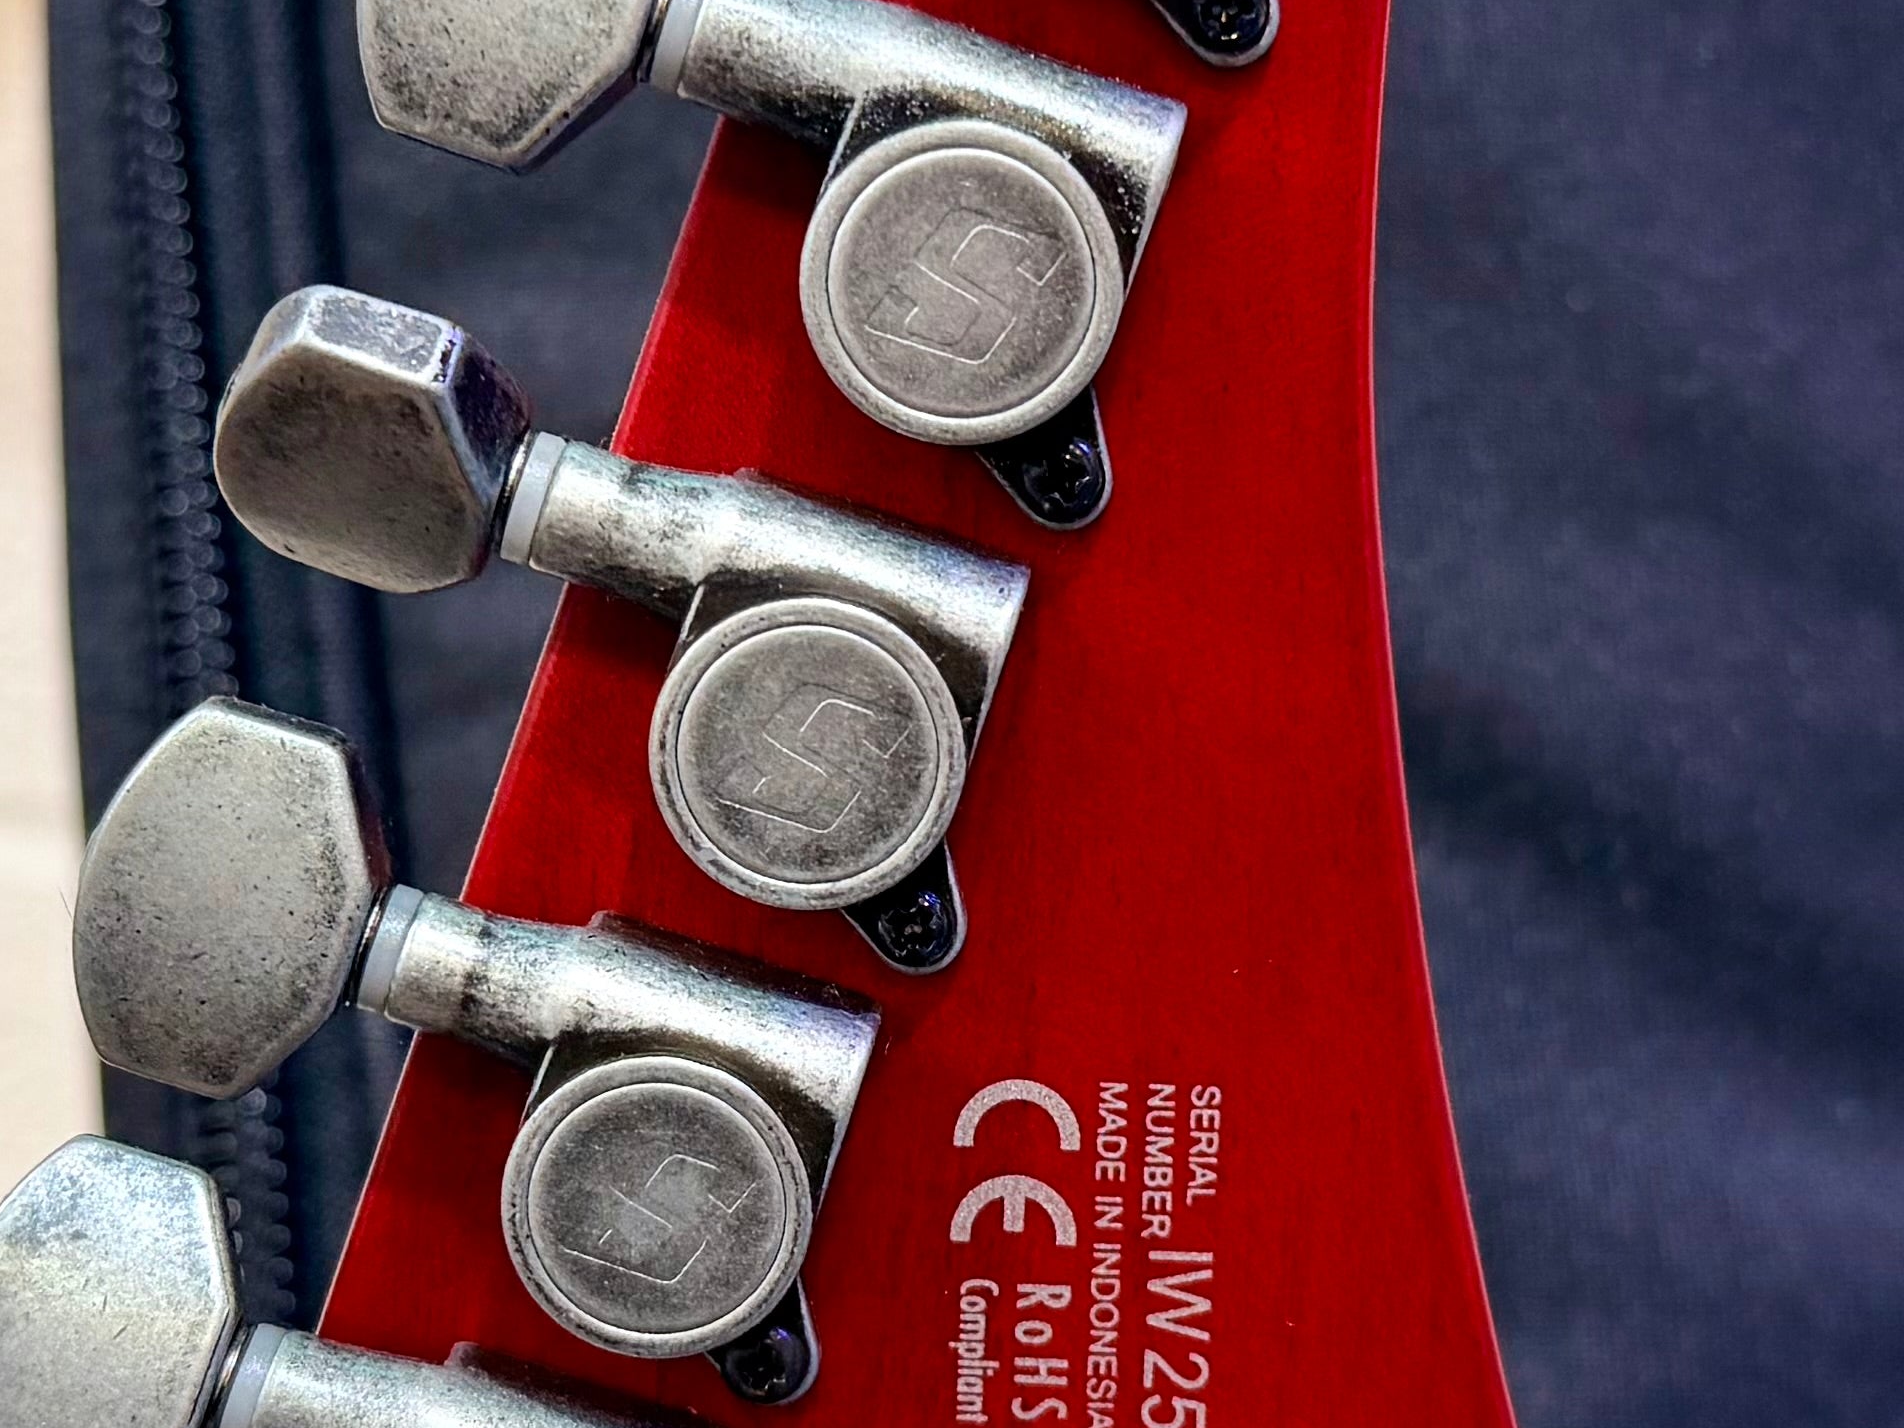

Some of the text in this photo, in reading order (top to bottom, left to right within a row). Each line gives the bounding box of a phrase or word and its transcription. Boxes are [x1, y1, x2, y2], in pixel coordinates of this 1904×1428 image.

[949, 1078, 1081, 1247] CE
[1095, 1081, 1129, 1182] MADE
[1140, 1083, 1176, 1238] NUMBER
[1185, 1084, 1222, 1206] SERIAL
[1093, 1195, 1124, 1230] IN
[948, 1278, 1000, 1424] Compliant
[1011, 1283, 1072, 1421] RoHS
